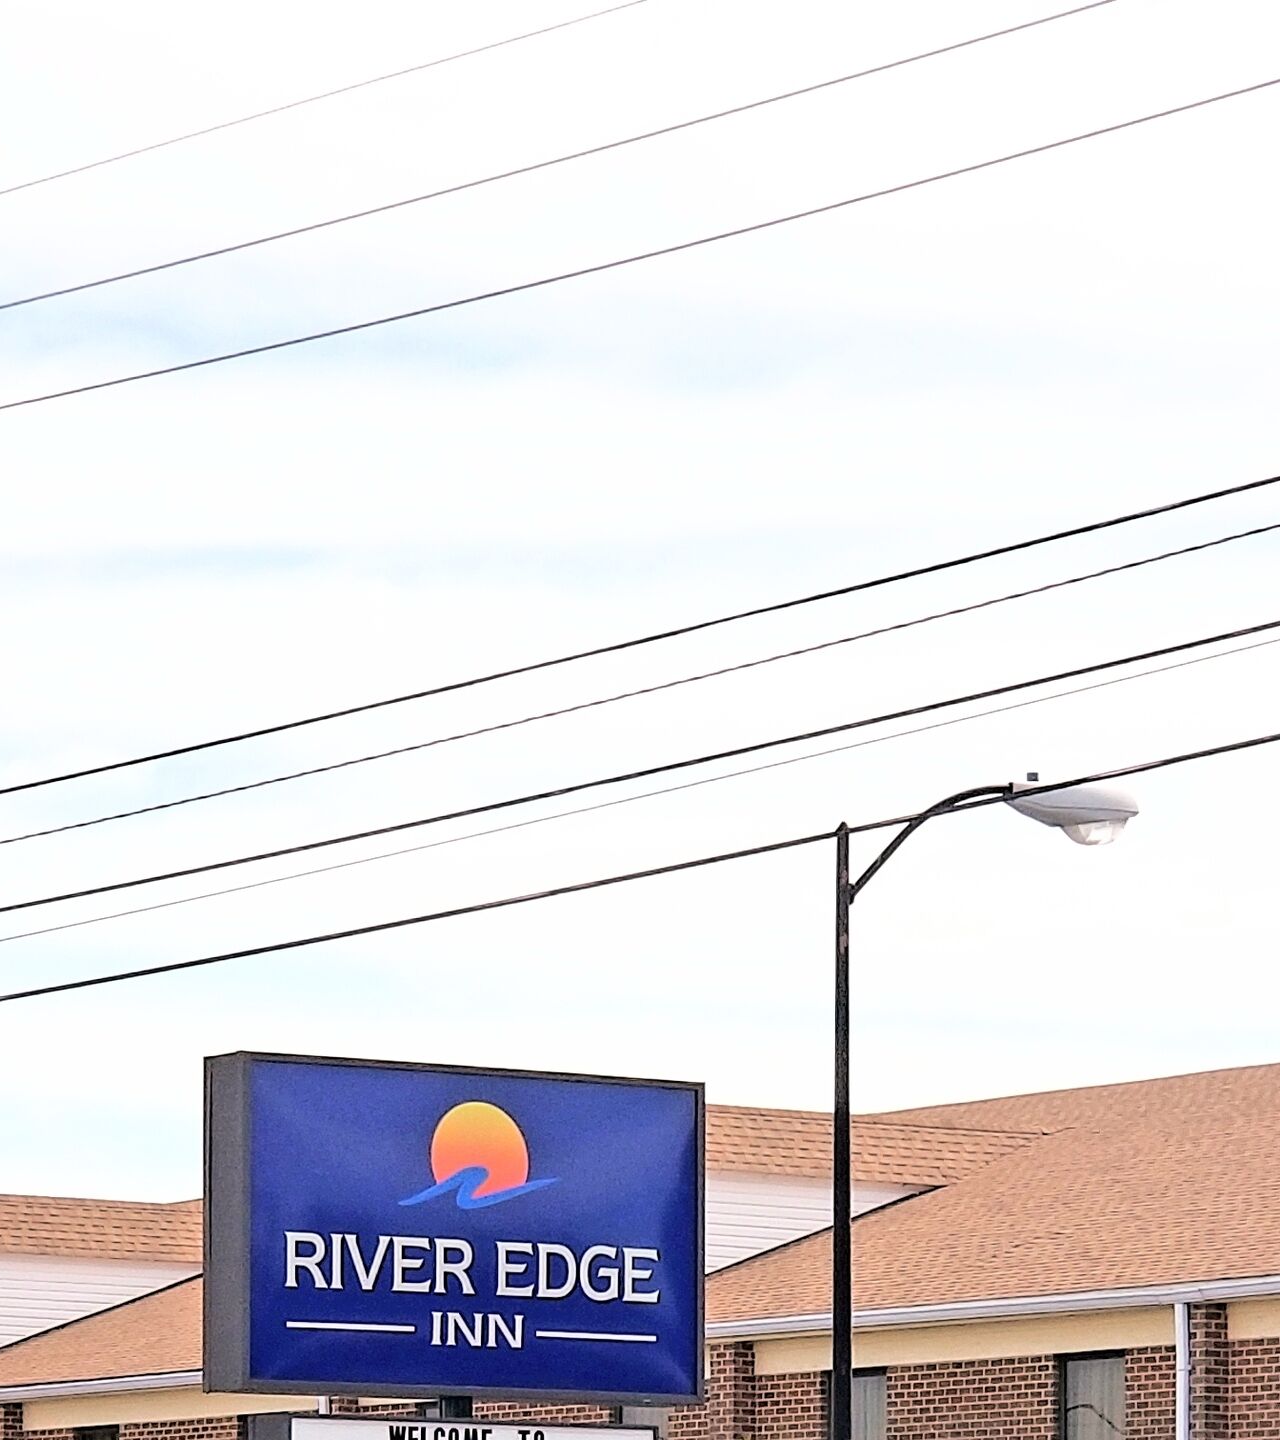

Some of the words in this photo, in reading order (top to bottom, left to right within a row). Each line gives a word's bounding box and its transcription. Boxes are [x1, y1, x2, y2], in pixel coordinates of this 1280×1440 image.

[284, 1231, 475, 1296] RIVER
[495, 1241, 660, 1303] EDGE
[430, 1311, 525, 1348] INN
